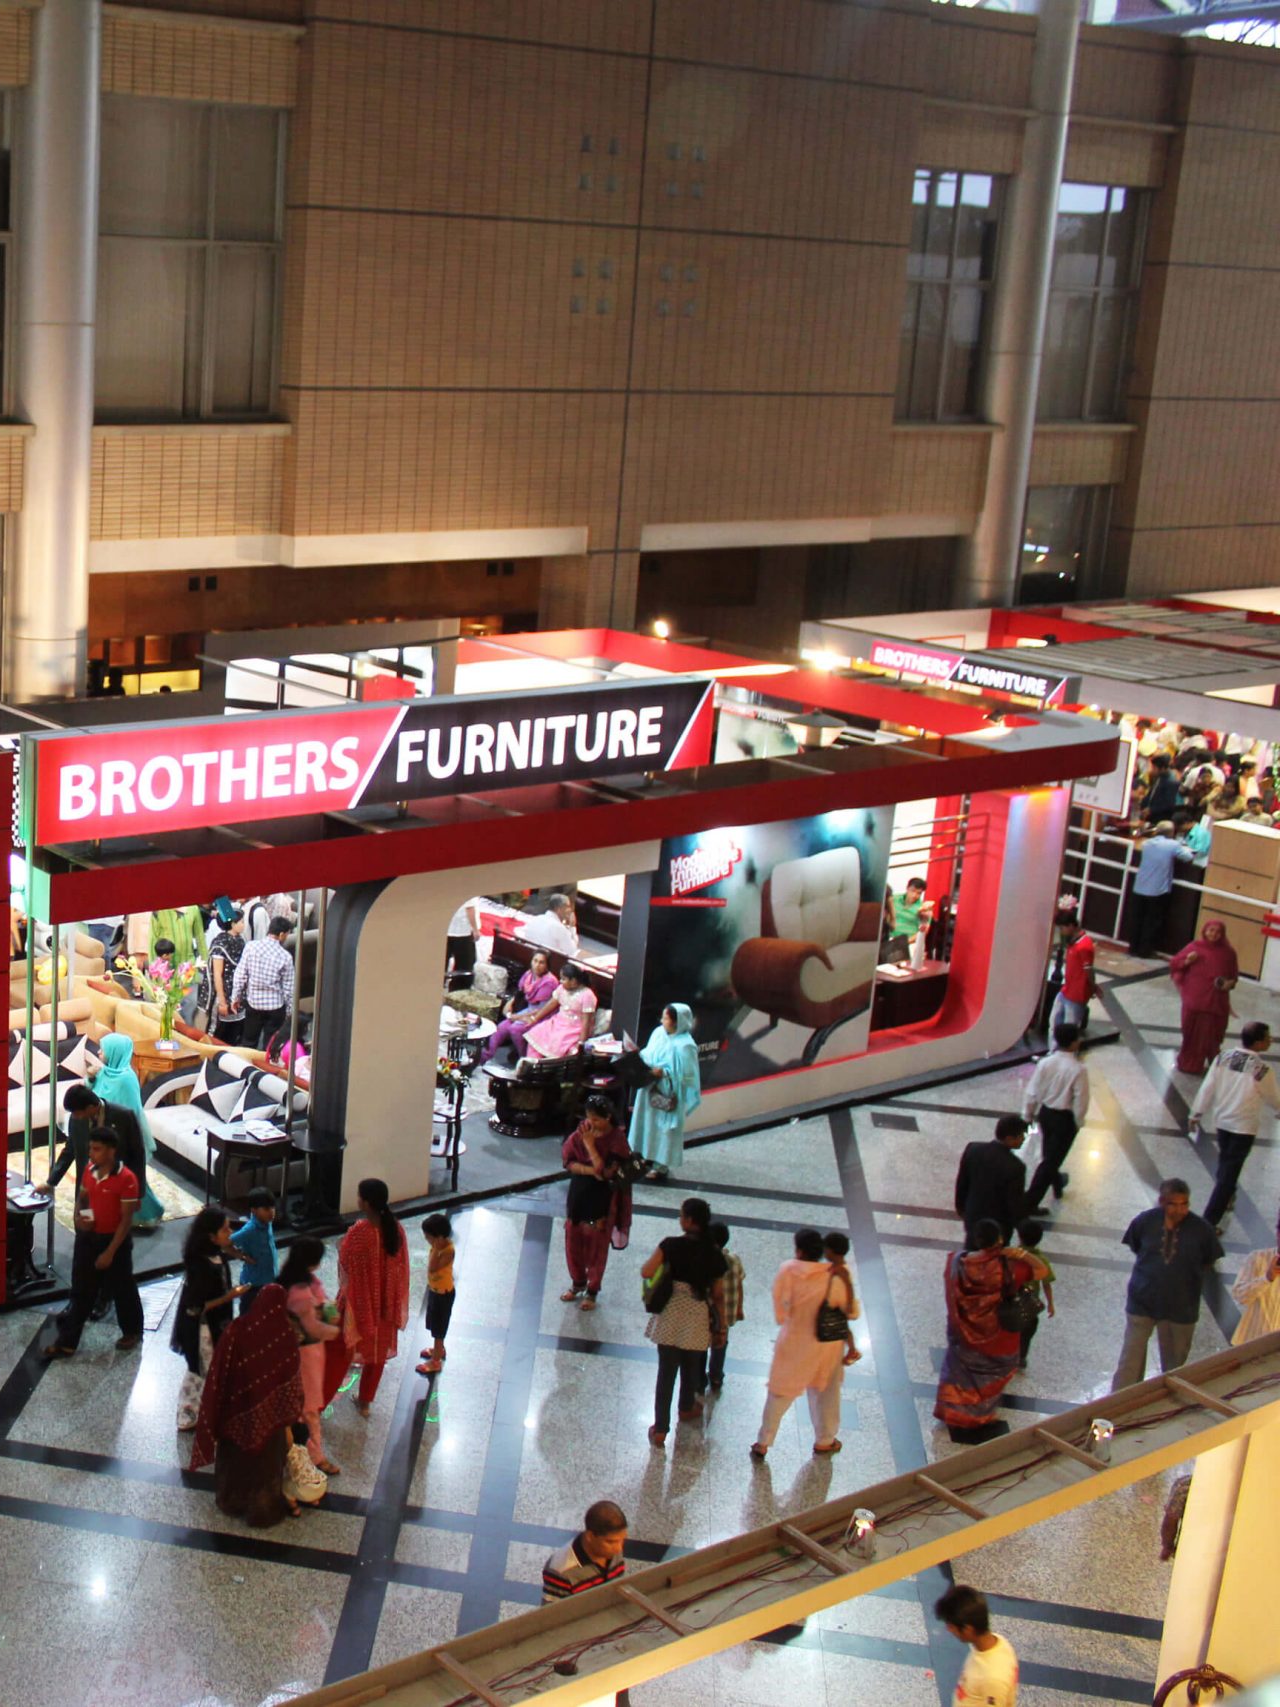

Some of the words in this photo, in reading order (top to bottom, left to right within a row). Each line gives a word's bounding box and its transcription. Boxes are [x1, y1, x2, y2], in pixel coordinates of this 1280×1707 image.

[874, 647, 951, 677] BROTHERS
[958, 664, 1048, 696] FURNITURE
[59, 736, 360, 822] BROTHERS
[396, 706, 664, 782] FURNITURE
